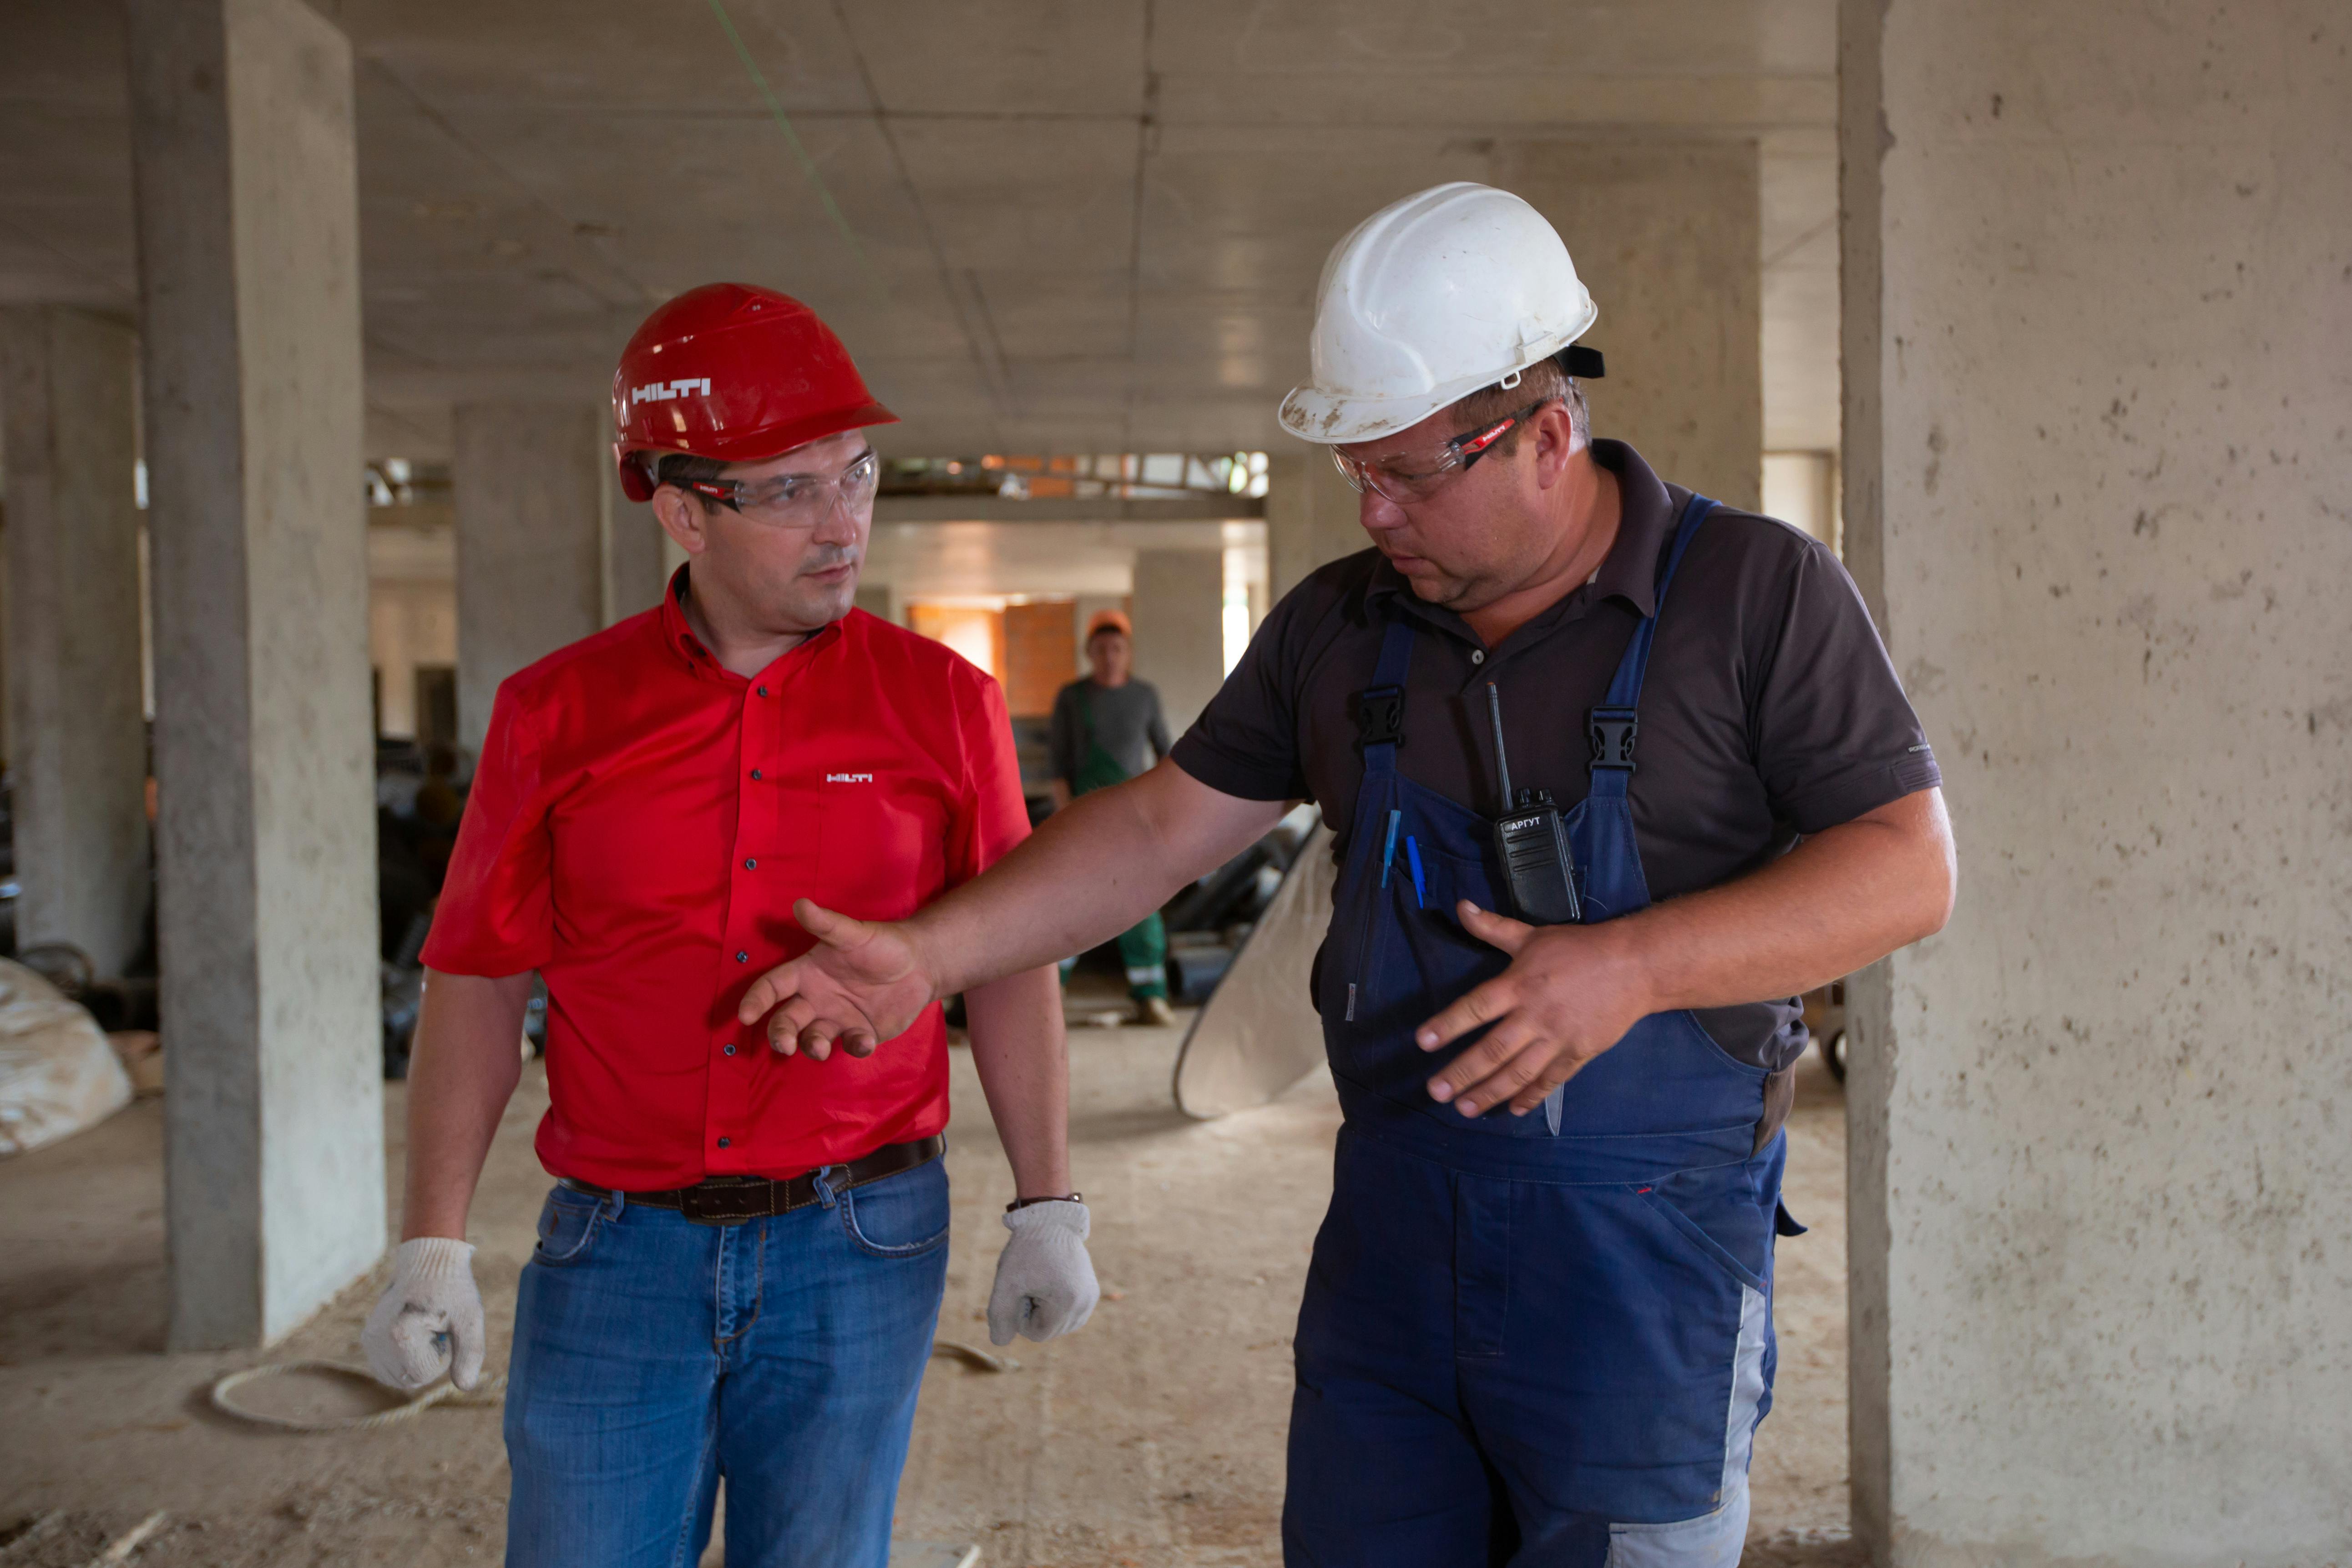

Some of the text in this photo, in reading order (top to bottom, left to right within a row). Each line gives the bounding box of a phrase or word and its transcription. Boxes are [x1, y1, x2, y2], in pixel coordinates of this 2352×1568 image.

[632, 377, 711, 405] HILTI
[1482, 425, 1505, 441] HILTI
[826, 773, 873, 783] HILTI
[1512, 817, 1540, 831] АРГУТ
